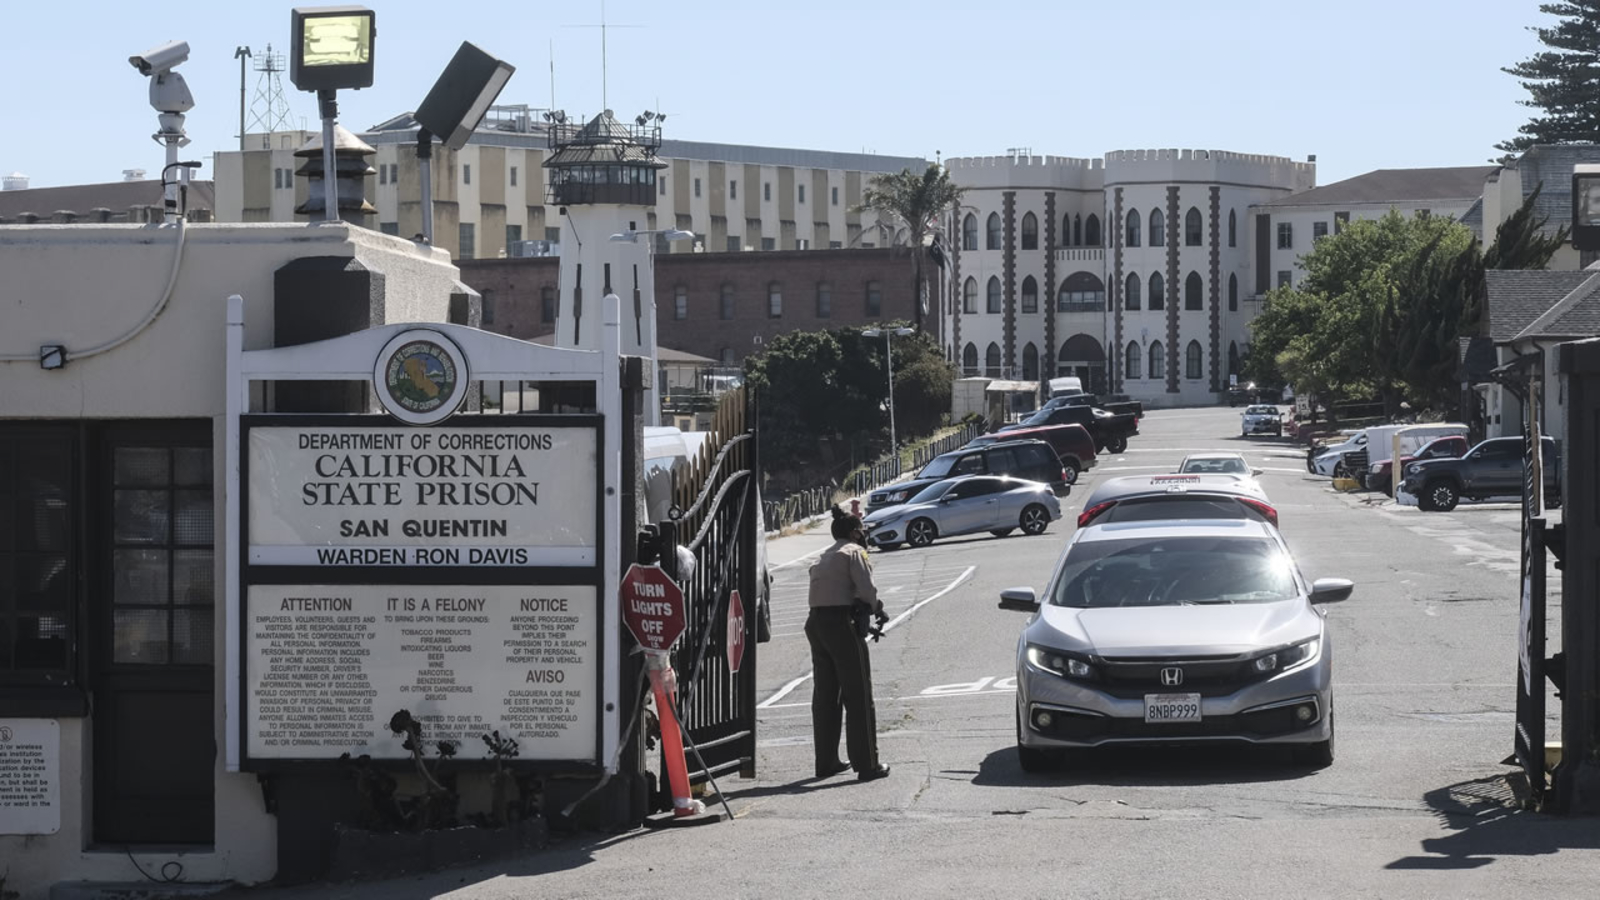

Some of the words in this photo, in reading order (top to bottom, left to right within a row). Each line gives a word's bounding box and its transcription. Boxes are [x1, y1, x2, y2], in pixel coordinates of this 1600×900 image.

[300, 434, 404, 450] DEPARTMENT
[410, 434, 432, 450] OF
[438, 434, 552, 450] CORRECTIONS
[315, 454, 526, 478] CALIFORNIA
[302, 482, 402, 506] STATE
[416, 482, 540, 506] PRISON
[340, 519, 389, 537] SAN
[402, 519, 507, 537] QUENTIN
[317, 549, 406, 565] WARDEN
[416, 549, 459, 565] RON
[469, 549, 528, 565] DAVIS
[632, 582, 665, 597] TURN
[280, 598, 352, 611] ATTENTION
[387, 598, 399, 611] IT
[404, 598, 416, 611] IS
[421, 598, 430, 611] A
[436, 598, 486, 611] FELONY
[520, 599, 568, 611] NOTICE
[631, 600, 673, 616] LIGHTS
[641, 619, 663, 634] OFF
[526, 670, 565, 683] AVISO
[1149, 704, 1197, 718] 8NBP999
